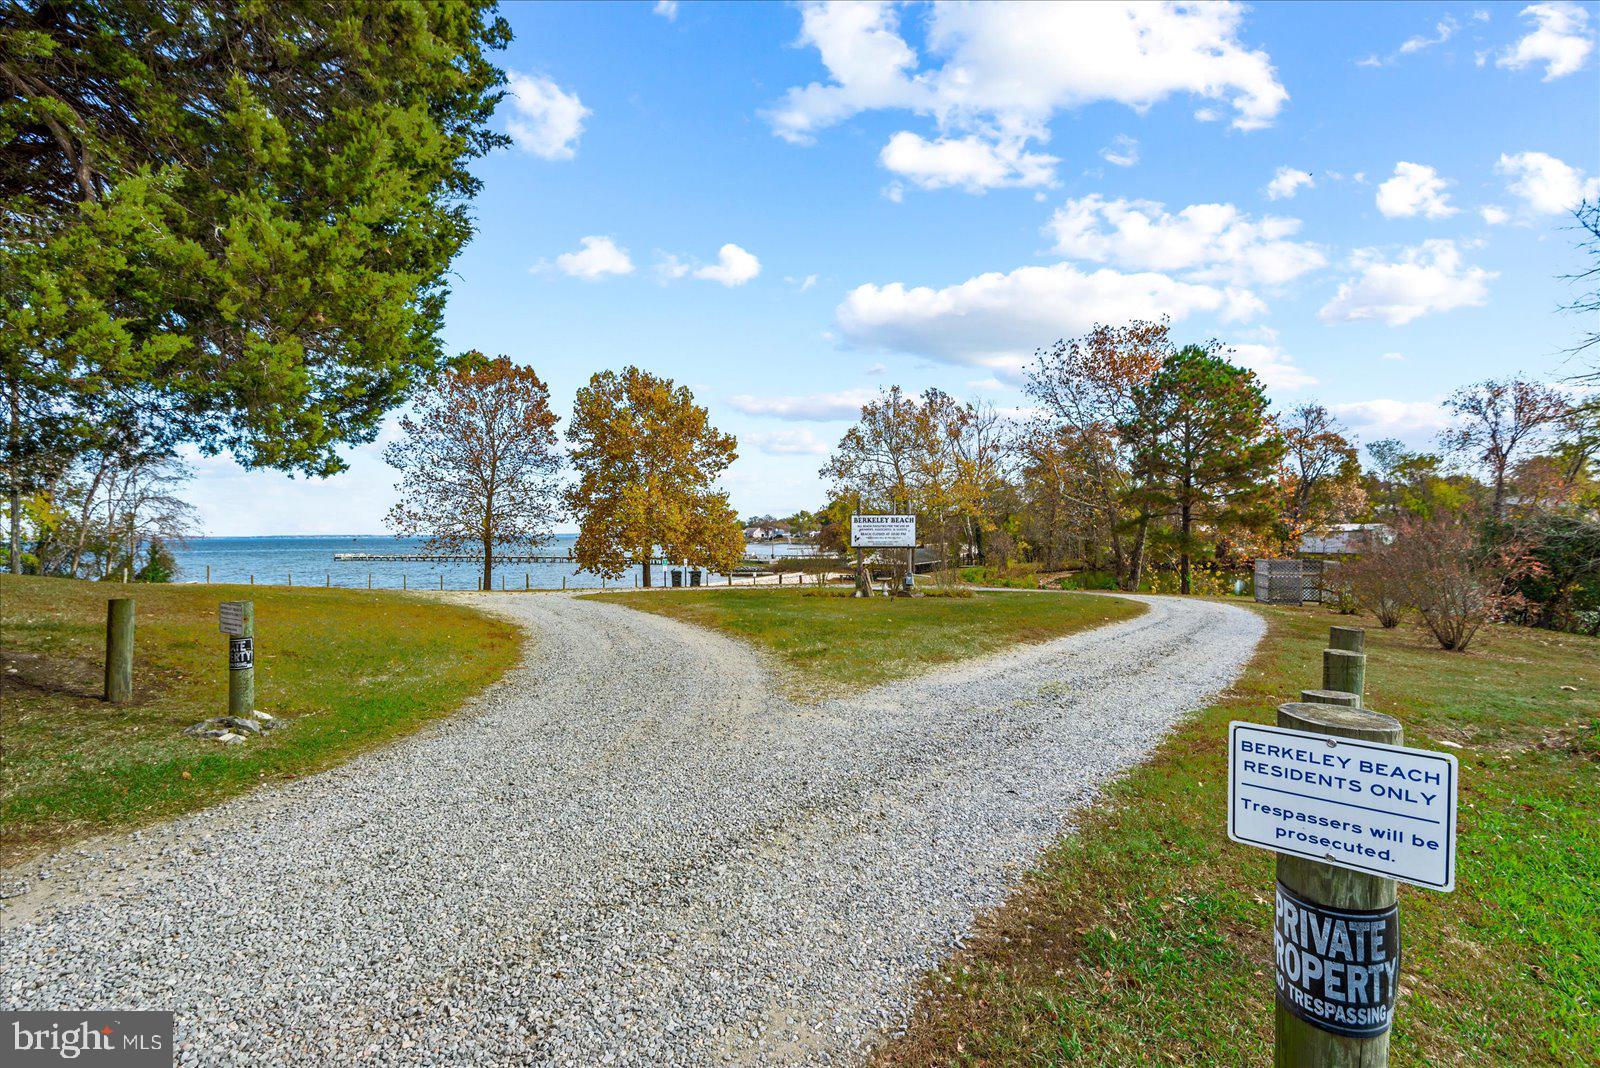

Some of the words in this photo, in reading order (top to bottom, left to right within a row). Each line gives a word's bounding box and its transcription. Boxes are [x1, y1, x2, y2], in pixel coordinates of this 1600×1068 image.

[1241, 740, 1351, 769] BERKELEY
[1359, 760, 1440, 785] BEACH
[1244, 760, 1362, 792] RESIDENTS
[1370, 784, 1437, 806] ONLY
[1241, 798, 1362, 834] Trespassers
[1369, 827, 1403, 843] will
[1412, 834, 1439, 850] be
[1275, 827, 1395, 863] prosecuted.
[1275, 889, 1386, 962] PRIVATE
[1287, 982, 1387, 1025] TRESPASSING
